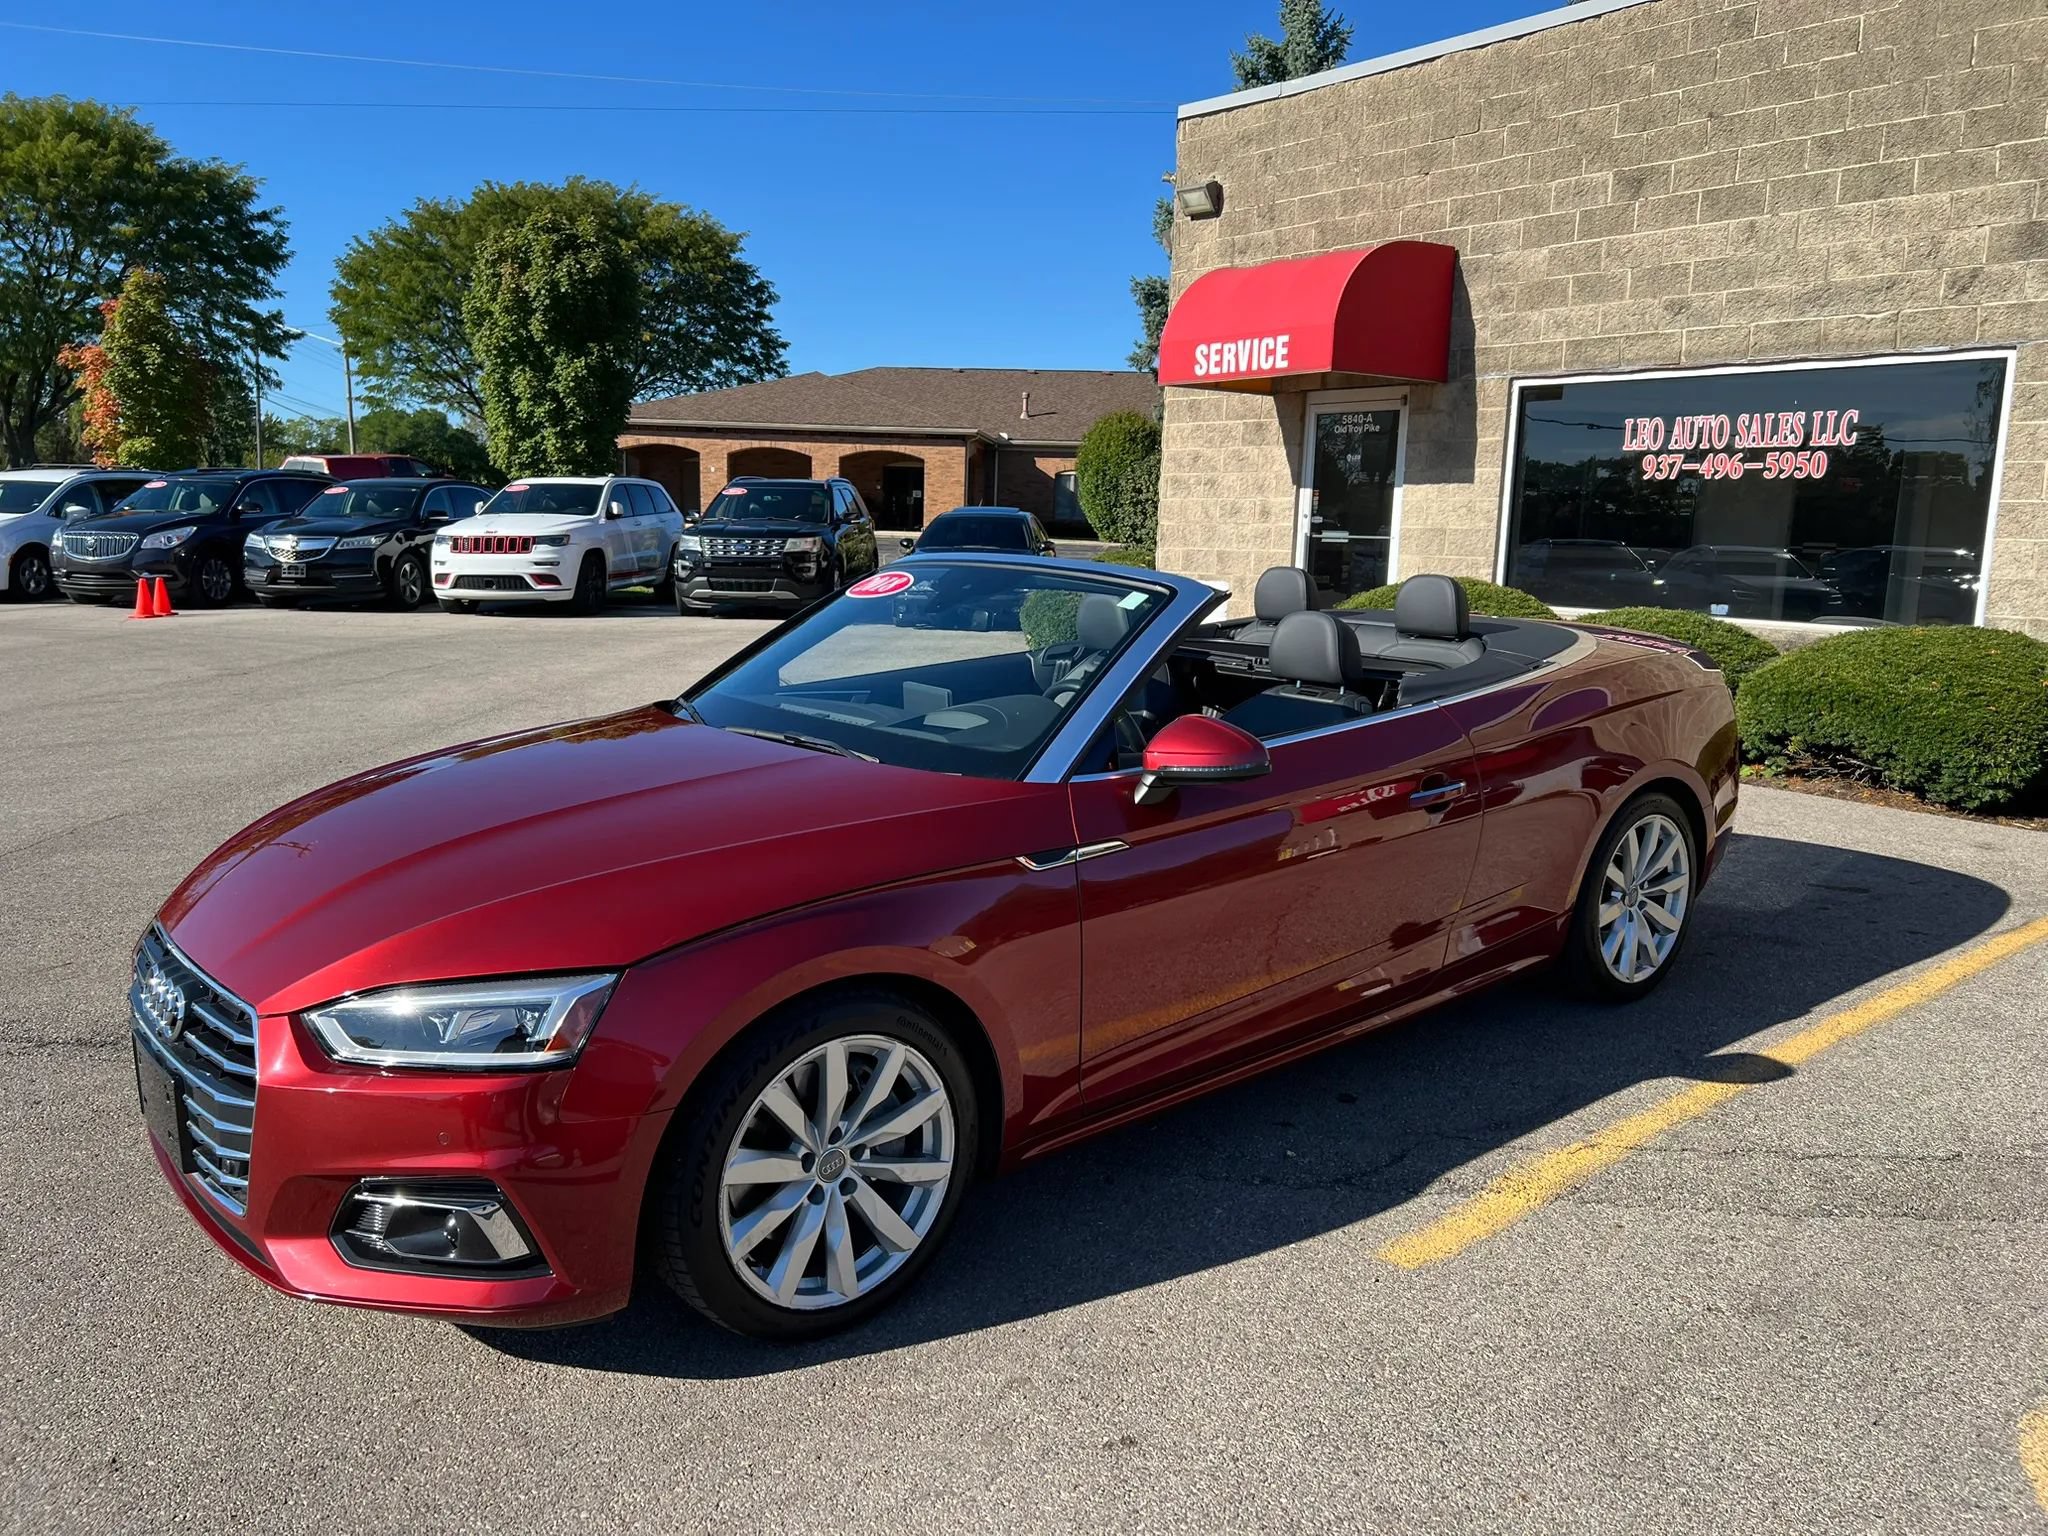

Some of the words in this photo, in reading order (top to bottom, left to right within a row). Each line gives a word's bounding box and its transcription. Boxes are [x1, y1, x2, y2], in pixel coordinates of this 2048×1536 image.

[1194, 334, 1290, 376] SERVICE
[1342, 413, 1373, 424] 5840-A
[1623, 417, 1665, 451] LEO
[1668, 414, 1731, 450] AUTO
[1735, 410, 1806, 448] SALES
[1810, 409, 1859, 447] LLC
[1642, 450, 1829, 480] 937-496-5950
